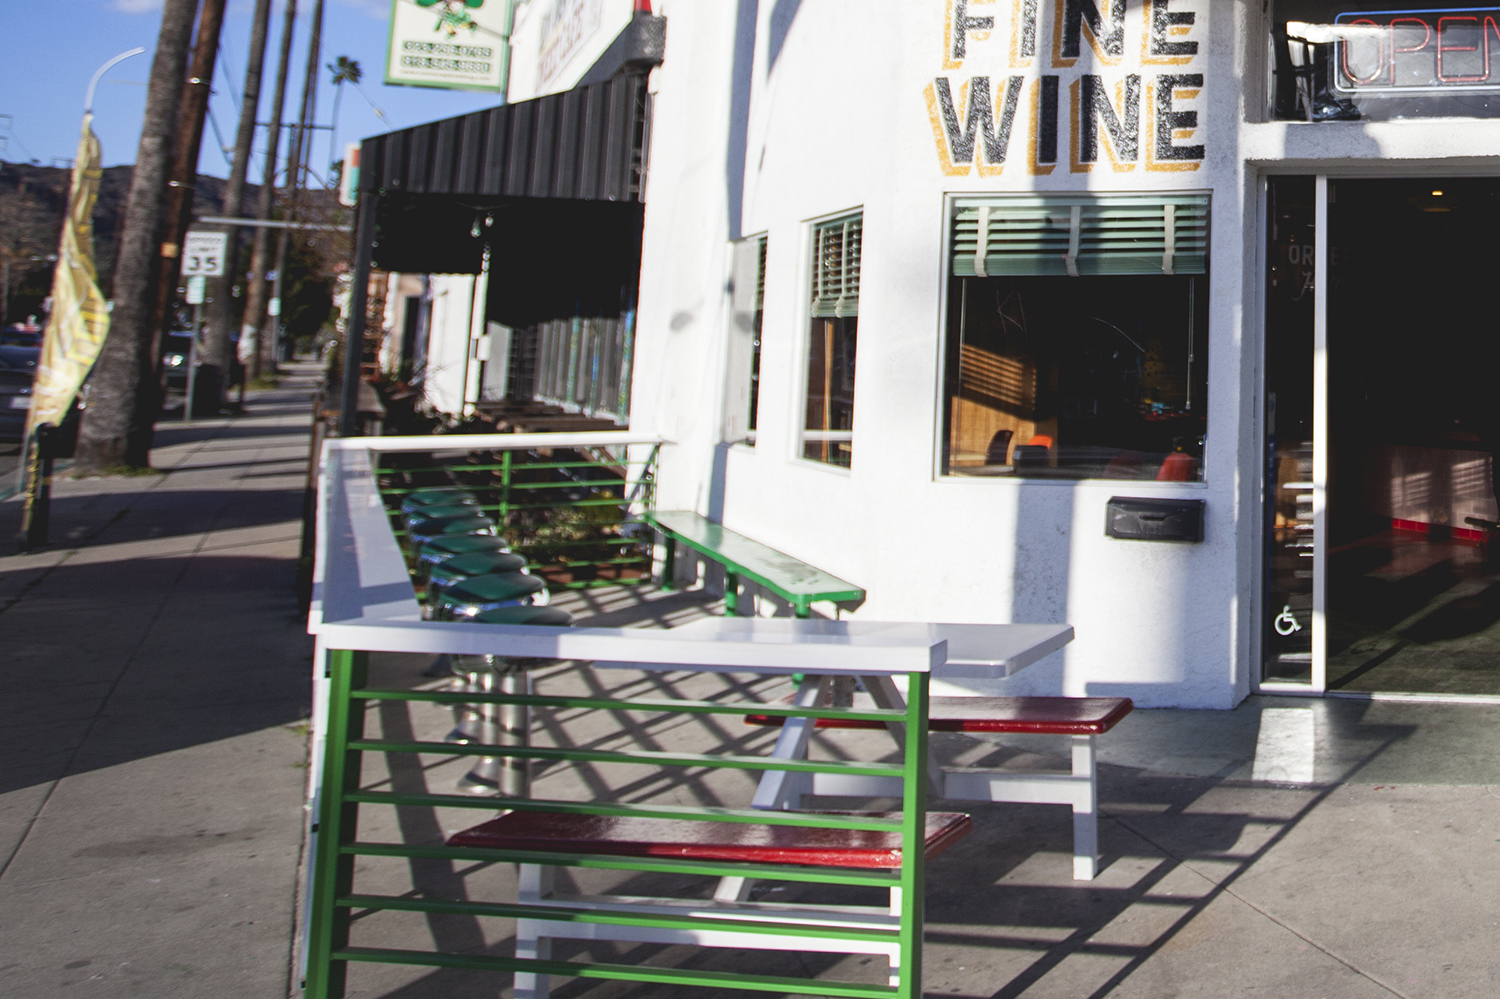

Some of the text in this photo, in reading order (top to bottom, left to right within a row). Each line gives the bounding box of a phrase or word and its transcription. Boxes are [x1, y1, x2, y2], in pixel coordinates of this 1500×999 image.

[922, 73, 1205, 177] WINE
[188, 256, 218, 272] 35
[1288, 244, 1352, 266] ORER
